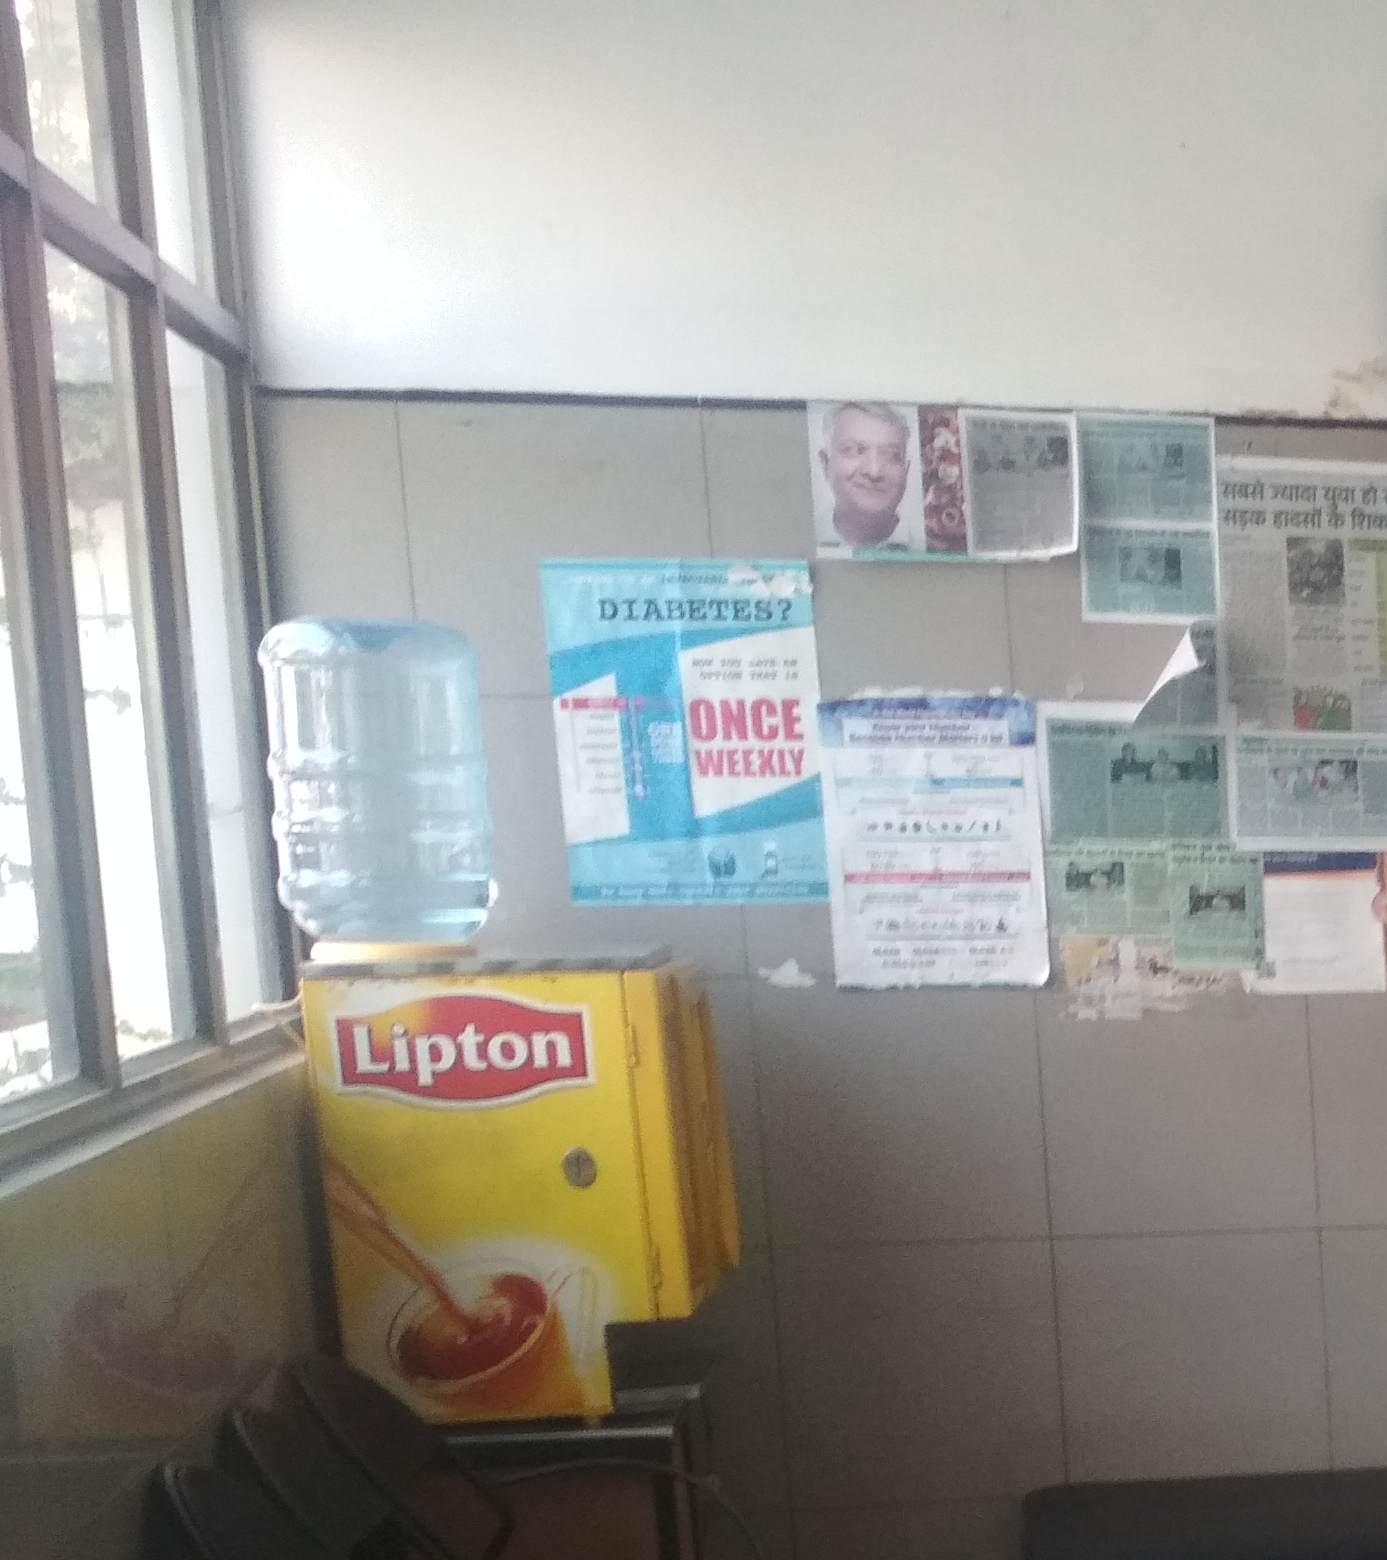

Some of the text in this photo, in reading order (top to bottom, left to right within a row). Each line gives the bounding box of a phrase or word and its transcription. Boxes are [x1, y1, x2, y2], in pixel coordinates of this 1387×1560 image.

[1222, 479, 1264, 501] सबसे
[599, 598, 792, 622] DIABETES?
[688, 696, 805, 742] ONCE
[695, 748, 805, 777] WEEKLY
[353, 1022, 574, 1088] Lipton
